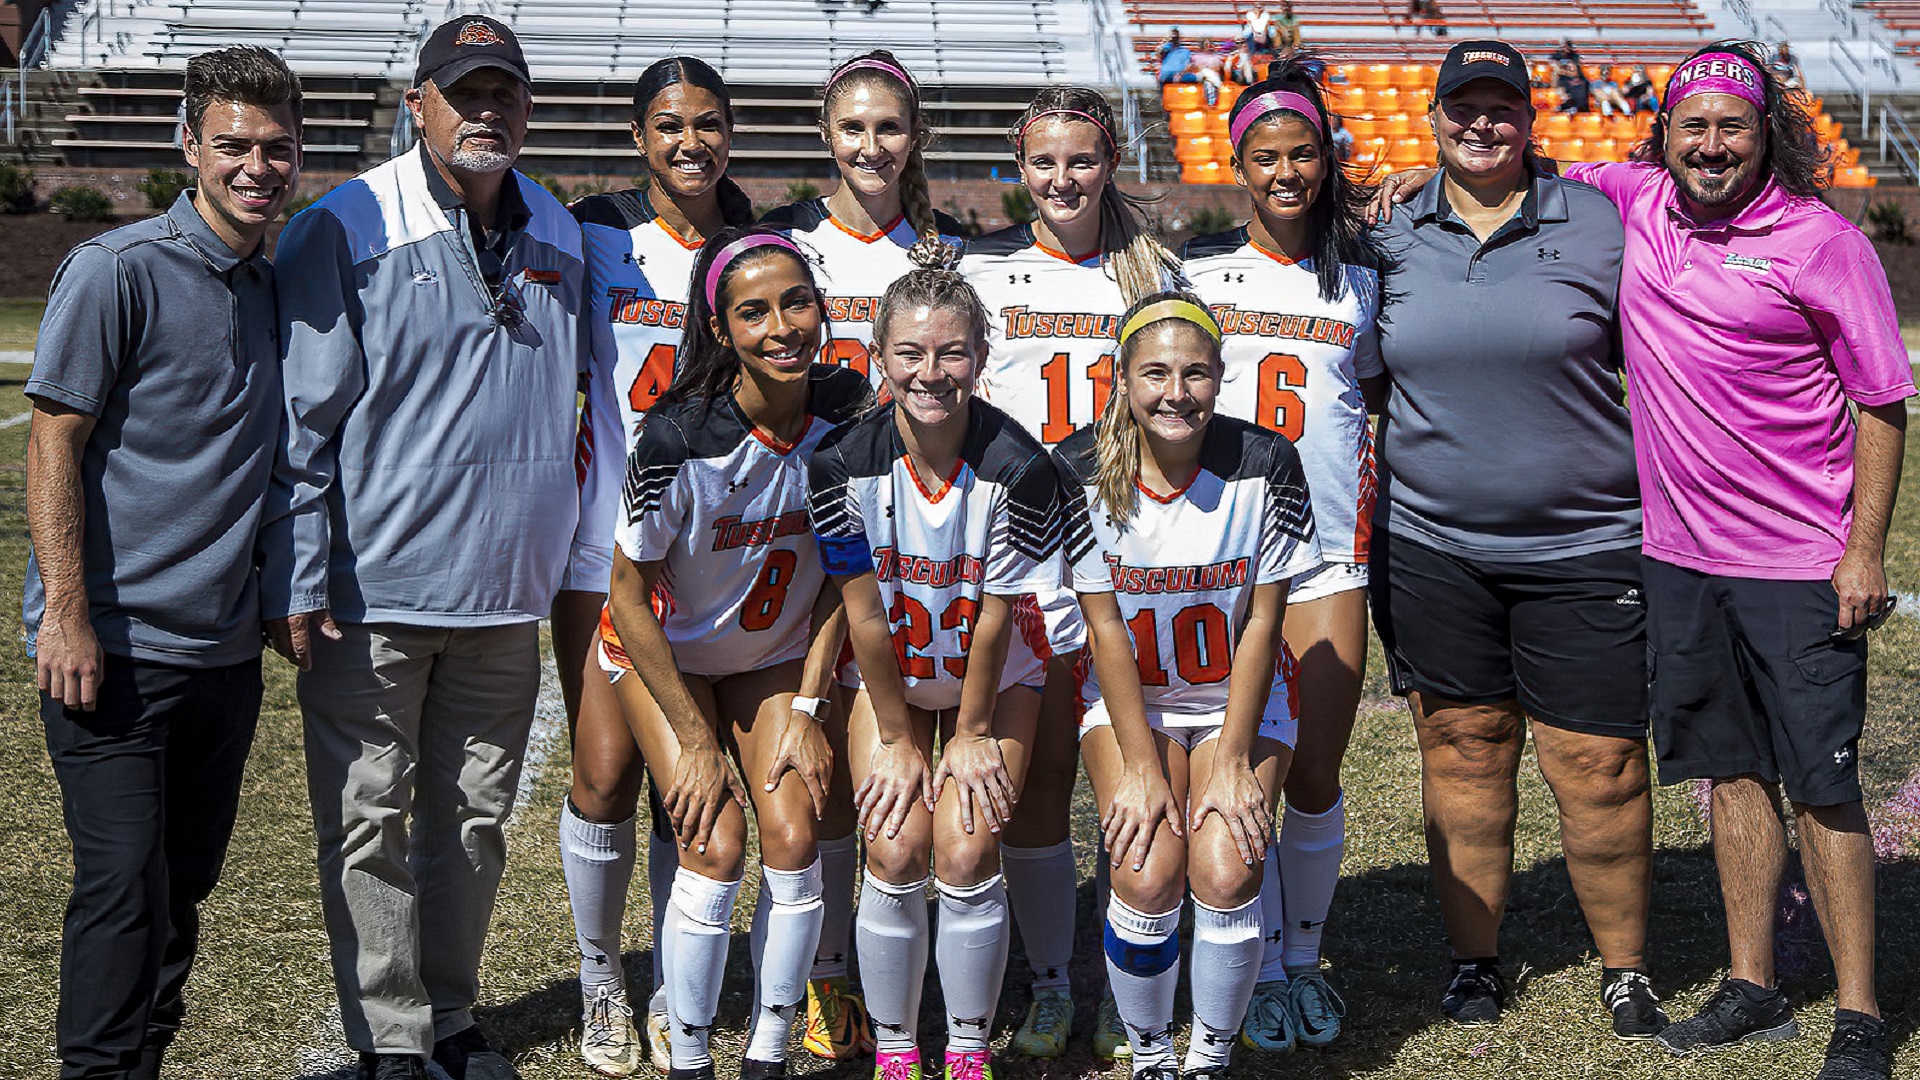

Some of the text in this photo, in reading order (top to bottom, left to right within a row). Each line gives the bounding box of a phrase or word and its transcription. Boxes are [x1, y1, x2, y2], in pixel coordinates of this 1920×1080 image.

[1678, 59, 1755, 89] NEERS
[607, 286, 689, 329] TUSC
[1000, 305, 1120, 339] TUSCUL
[1209, 303, 1357, 350] TUSCULUM
[628, 343, 677, 412] 4
[1041, 352, 1115, 443] 11
[1255, 352, 1308, 443] 6
[739, 549, 797, 632] 8
[820, 540, 848, 572] C
[888, 591, 979, 679] 23
[1126, 602, 1232, 687] 10
